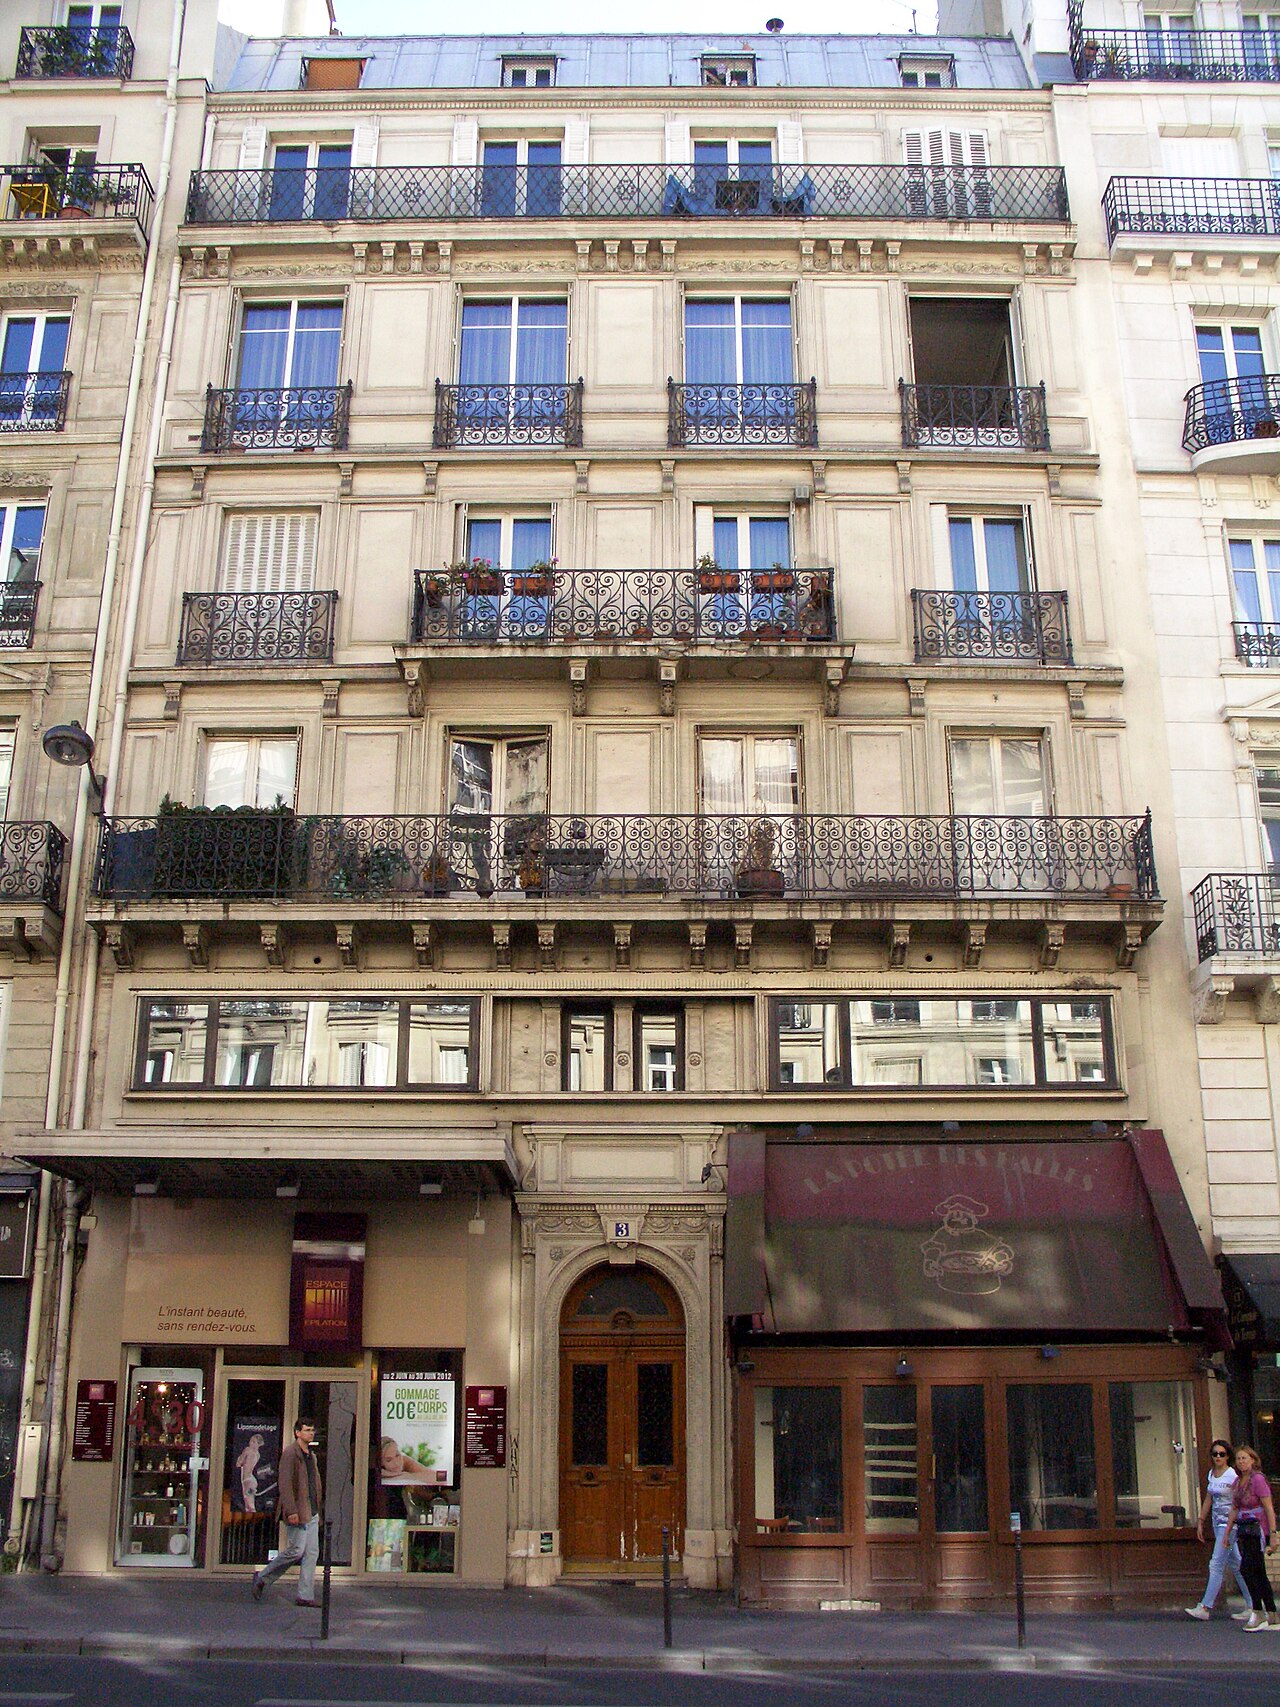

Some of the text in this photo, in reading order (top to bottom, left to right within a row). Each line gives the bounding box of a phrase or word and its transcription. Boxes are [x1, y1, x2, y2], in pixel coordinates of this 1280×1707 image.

[618, 1223, 627, 1237] 3
[306, 1280, 348, 1289] ESPACE
[158, 1305, 247, 1320] L'instant beauté,
[157, 1321, 257, 1333] sans rendez-vous.
[437, 1372, 452, 1380] 2012
[395, 1388, 440, 1400] GOMMAGE
[417, 1401, 448, 1414] CORPS
